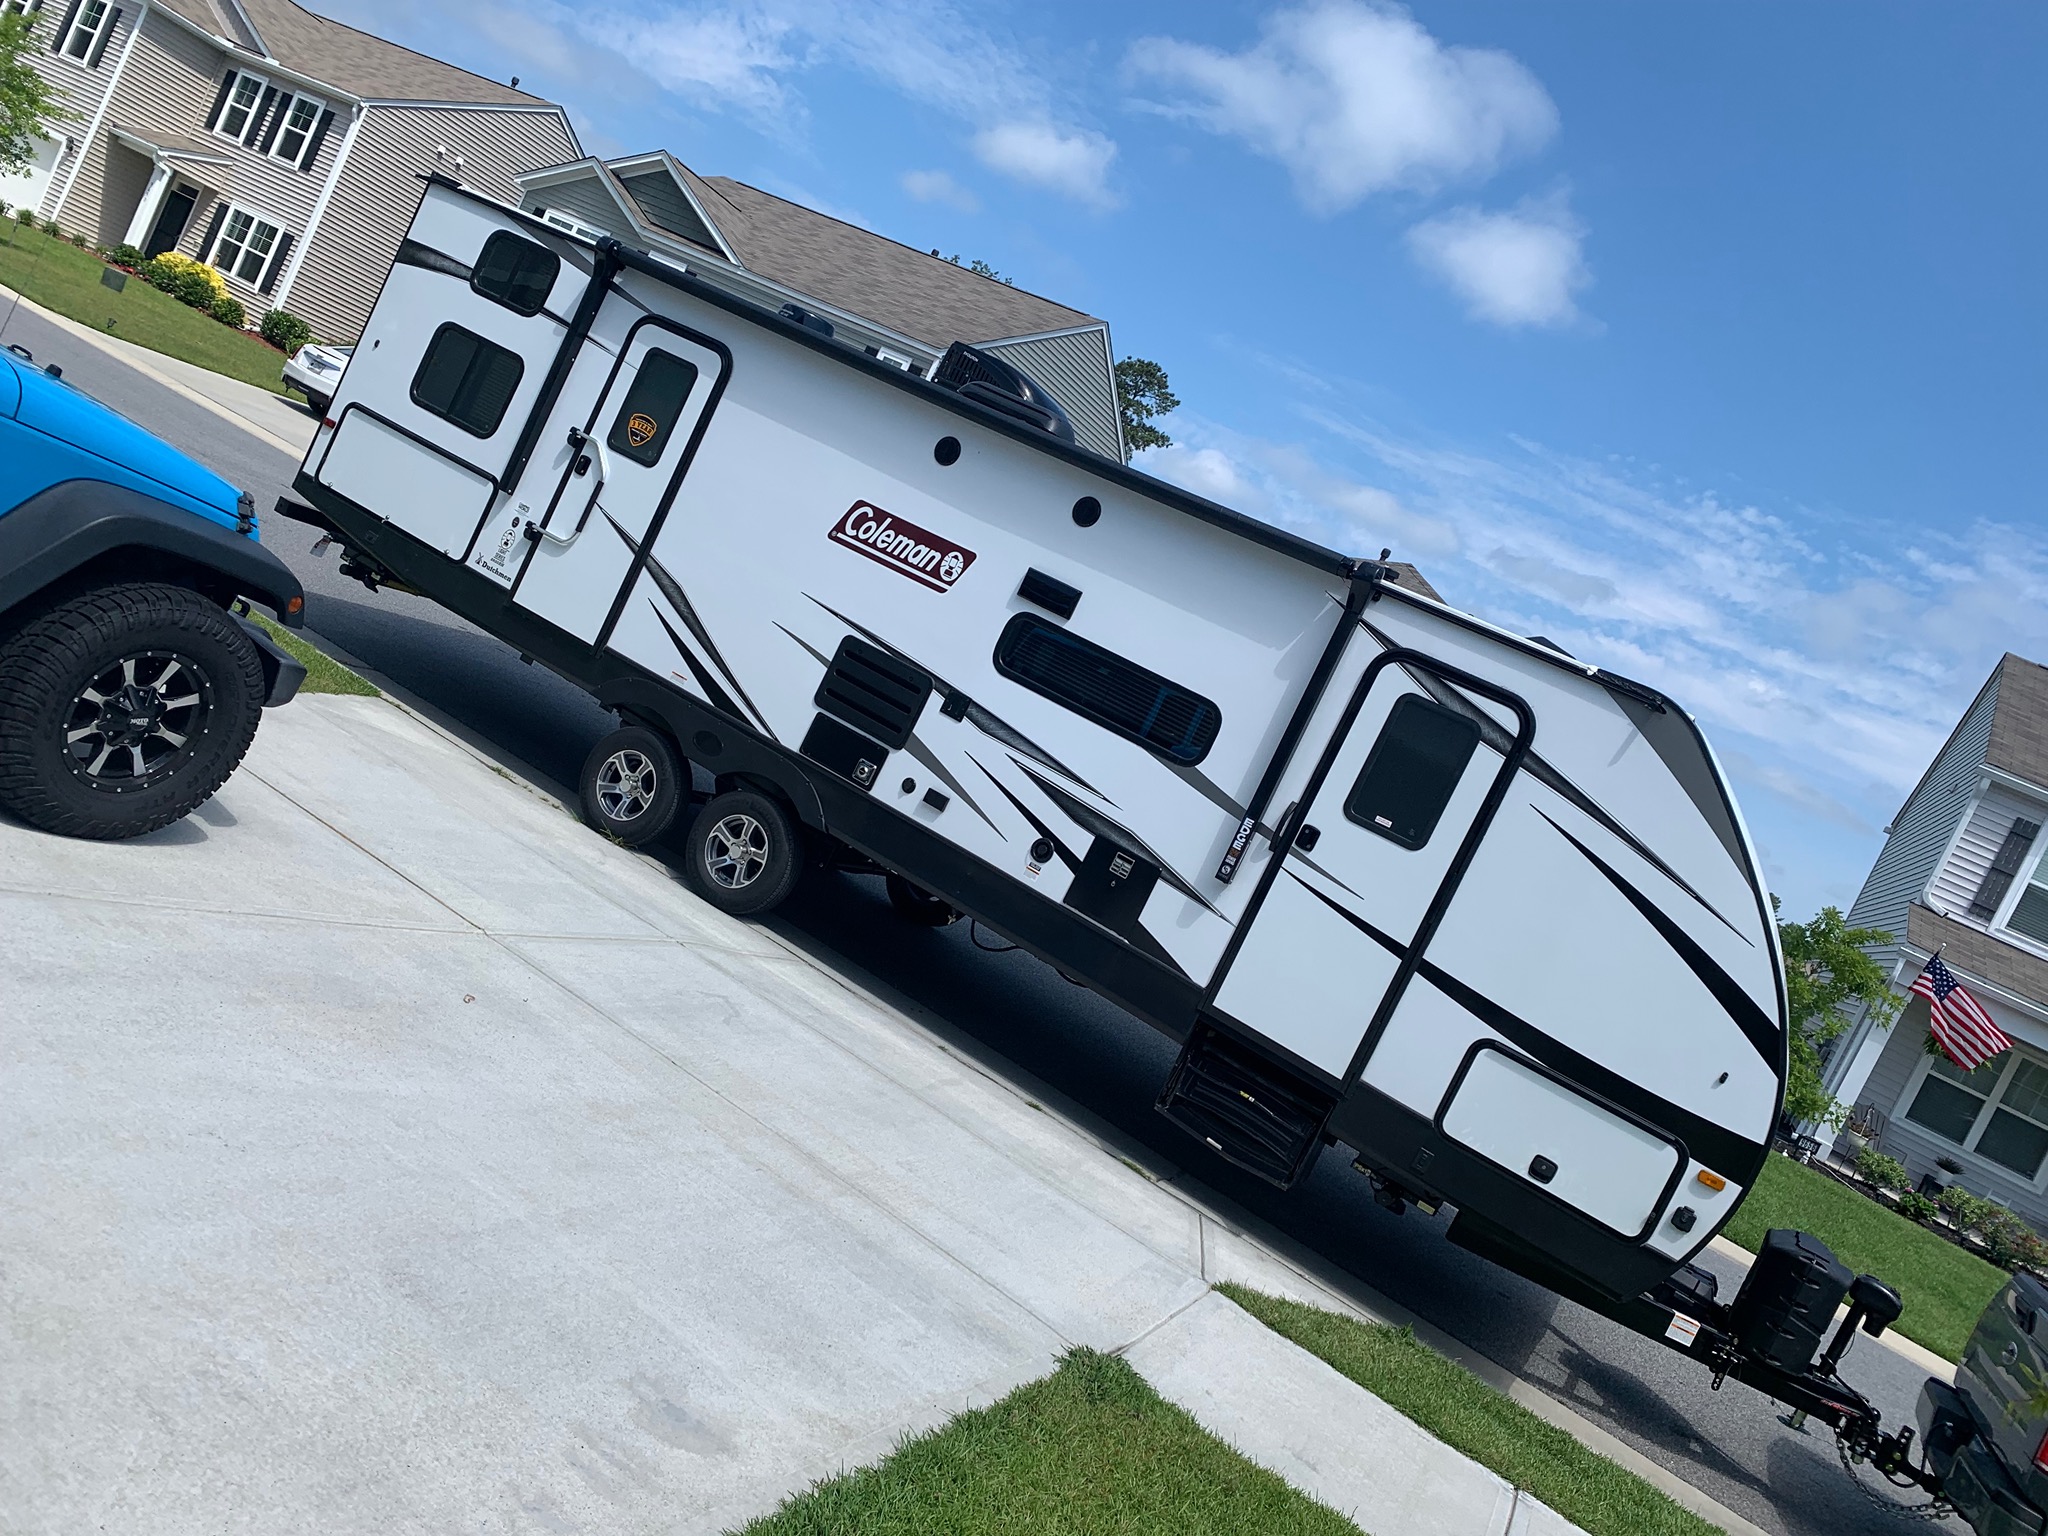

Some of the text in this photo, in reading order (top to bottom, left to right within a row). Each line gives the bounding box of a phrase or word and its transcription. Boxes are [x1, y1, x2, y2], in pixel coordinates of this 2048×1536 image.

[637, 421, 652, 434] YEAR
[844, 505, 942, 572] Coleman
[482, 561, 512, 582] Dutchmen
[1232, 817, 1255, 850] EDGE
